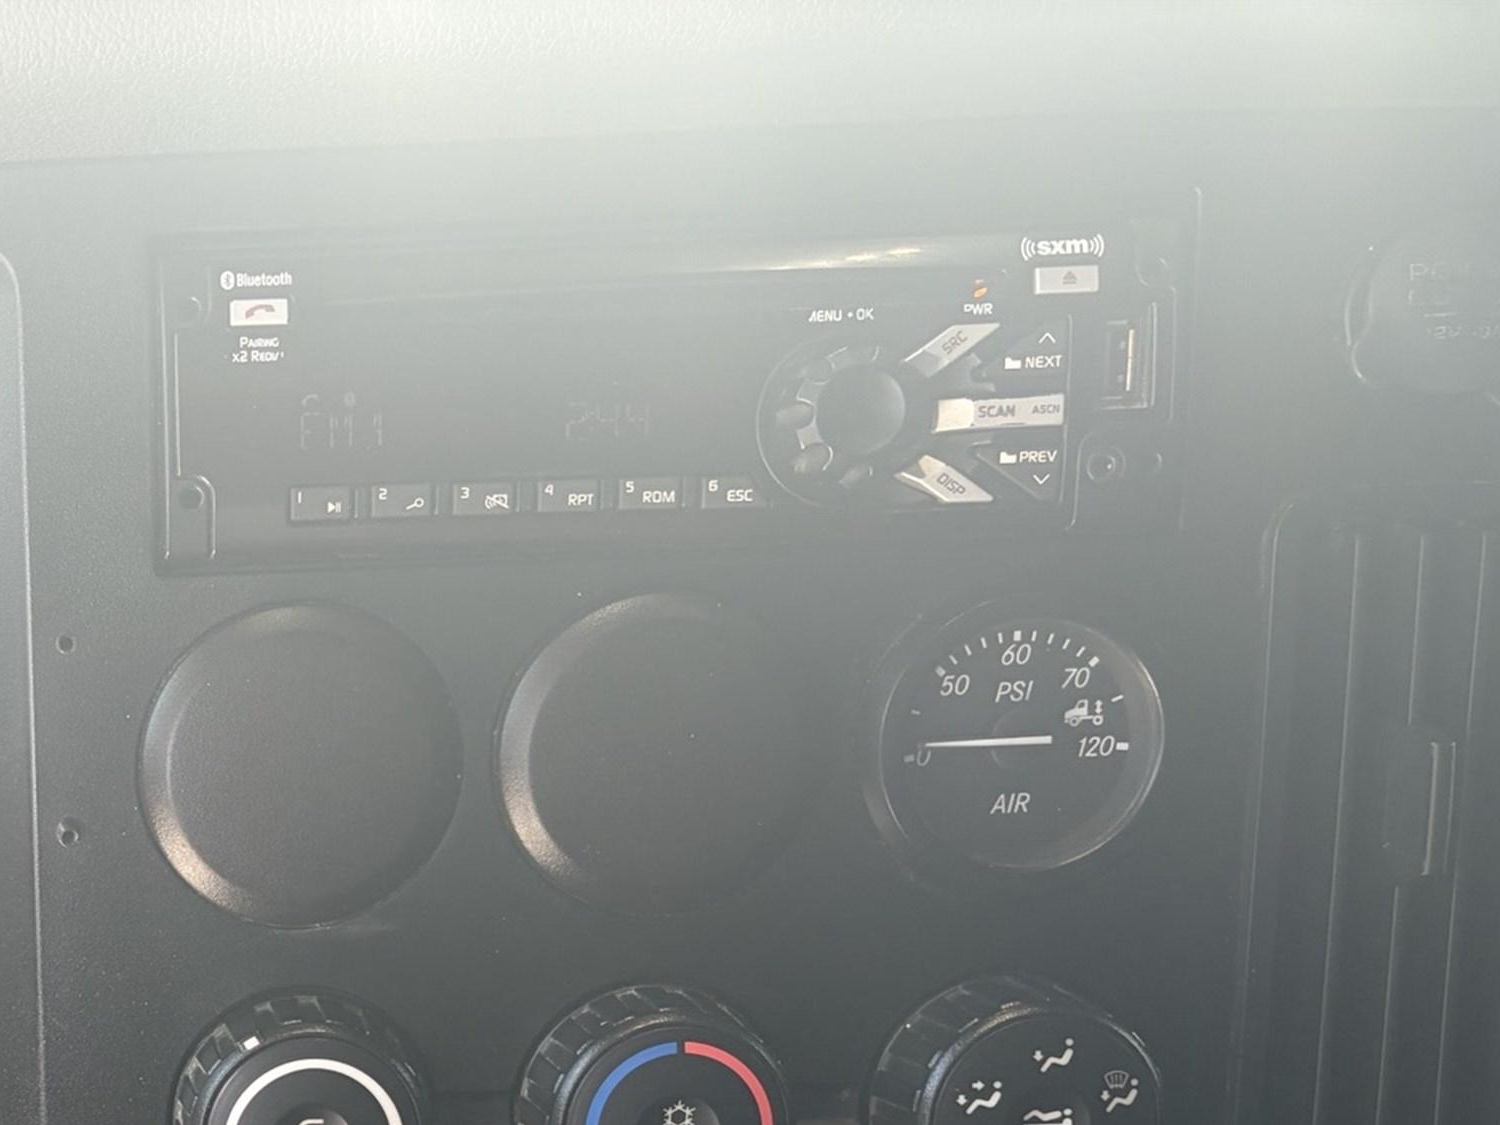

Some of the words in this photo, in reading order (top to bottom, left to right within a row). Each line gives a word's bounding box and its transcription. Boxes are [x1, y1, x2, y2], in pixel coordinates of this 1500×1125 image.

[236, 271, 293, 288] Bluetooth
[856, 307, 875, 321] OK
[941, 330, 969, 355] SRC
[1024, 354, 1064, 370] NEXT
[977, 403, 1017, 419] SCAN
[1019, 448, 1058, 464] PREV
[378, 488, 388, 501] 2
[459, 487, 470, 499] 3
[544, 483, 554, 496] 4
[567, 493, 595, 507] RPT
[625, 481, 635, 493] 5
[642, 490, 676, 504] RDM
[708, 480, 718, 492] 6
[726, 488, 754, 503] ESC
[936, 471, 967, 498] DISP
[1001, 644, 1032, 666] 60
[940, 674, 970, 697] 50
[1061, 667, 1090, 689] 70
[995, 680, 1033, 703] PSI
[1077, 736, 1115, 758] 120
[990, 793, 1030, 815] AIR
